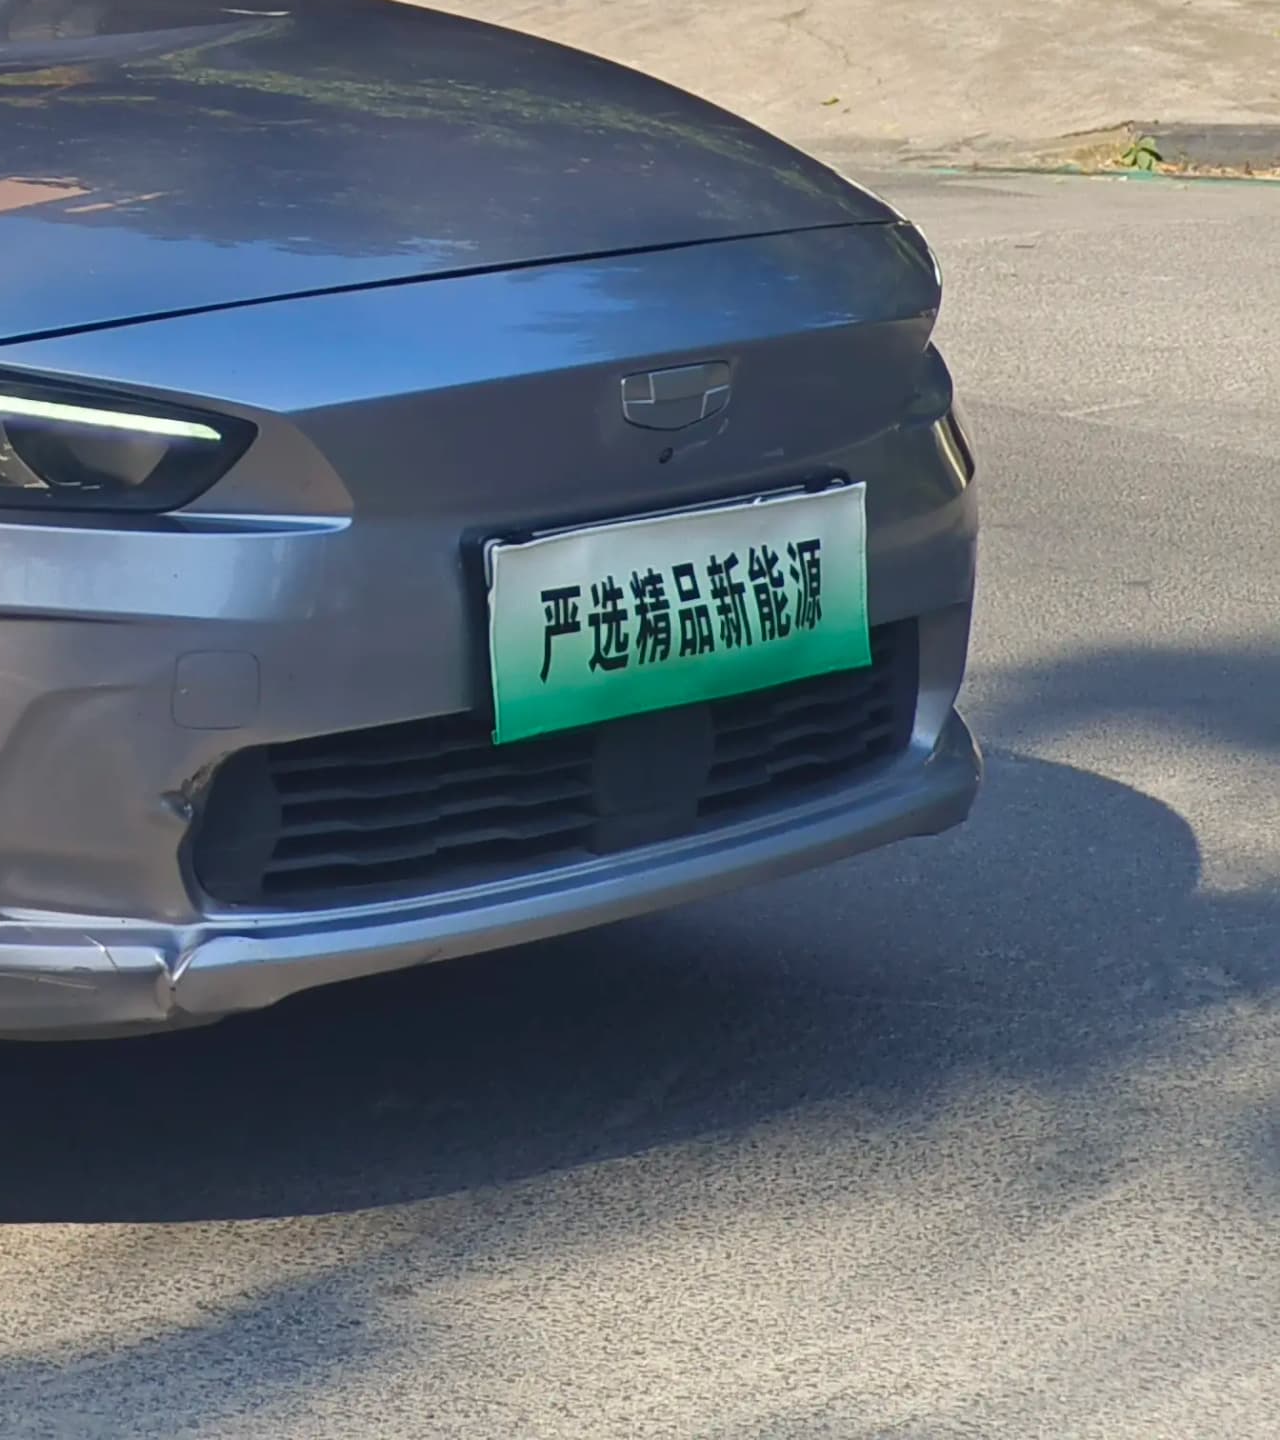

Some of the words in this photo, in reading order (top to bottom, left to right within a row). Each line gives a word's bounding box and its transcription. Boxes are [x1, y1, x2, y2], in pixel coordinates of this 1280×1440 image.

[539, 537, 824, 684] 严选精品新能源
